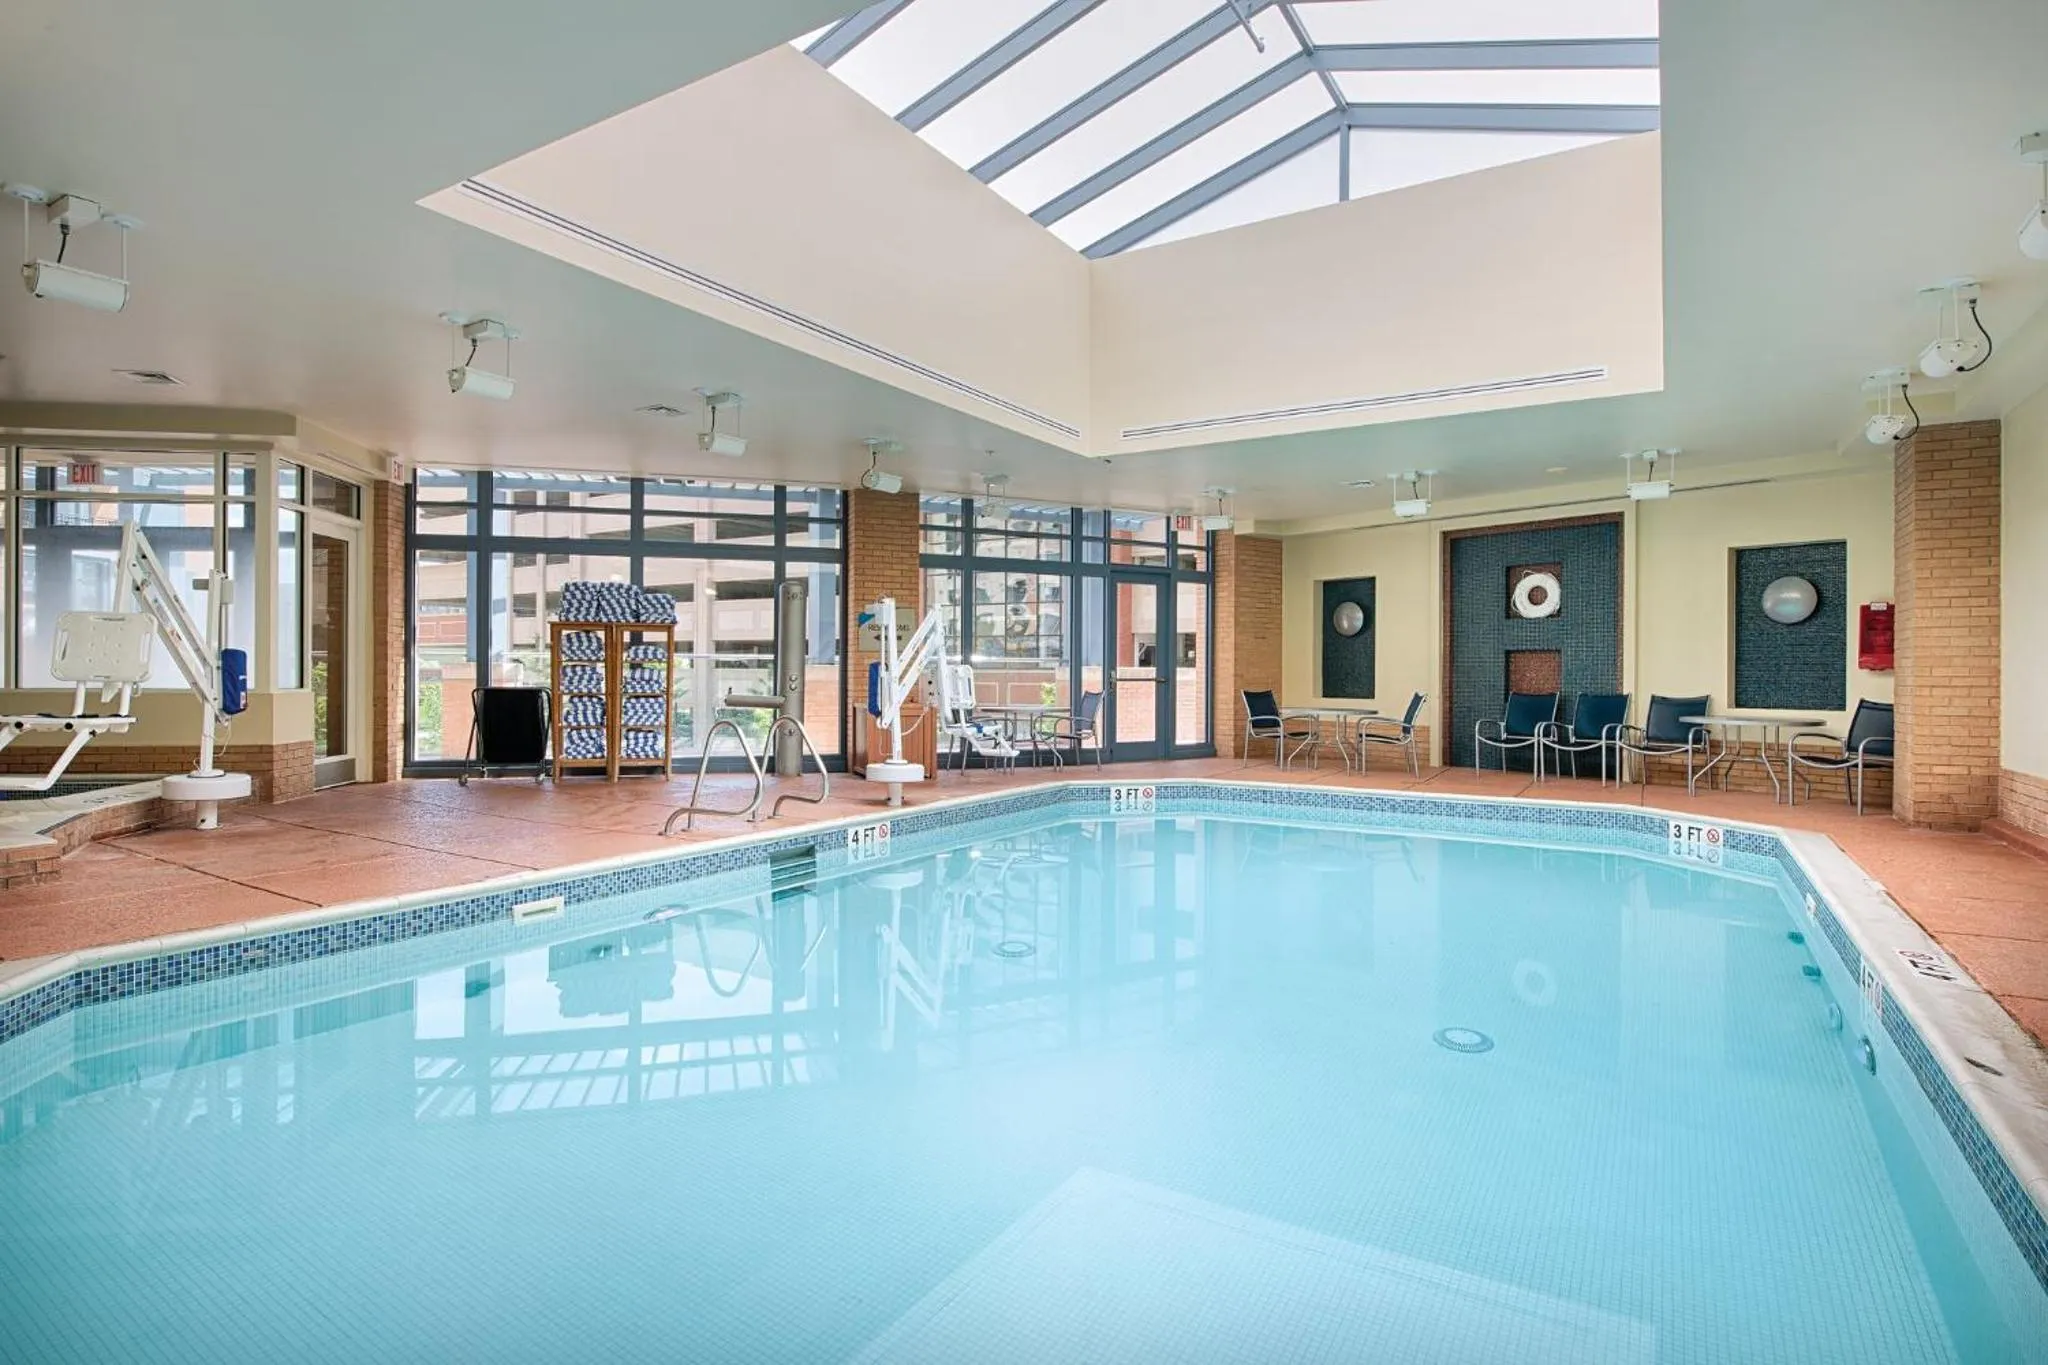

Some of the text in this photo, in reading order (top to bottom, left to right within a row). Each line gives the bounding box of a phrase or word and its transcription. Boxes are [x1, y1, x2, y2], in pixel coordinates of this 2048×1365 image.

[72, 464, 96, 483] EXIT
[1114, 788, 1139, 801] 3 FT
[852, 826, 876, 845] 4 FT
[1673, 824, 1703, 842] 3 FT
